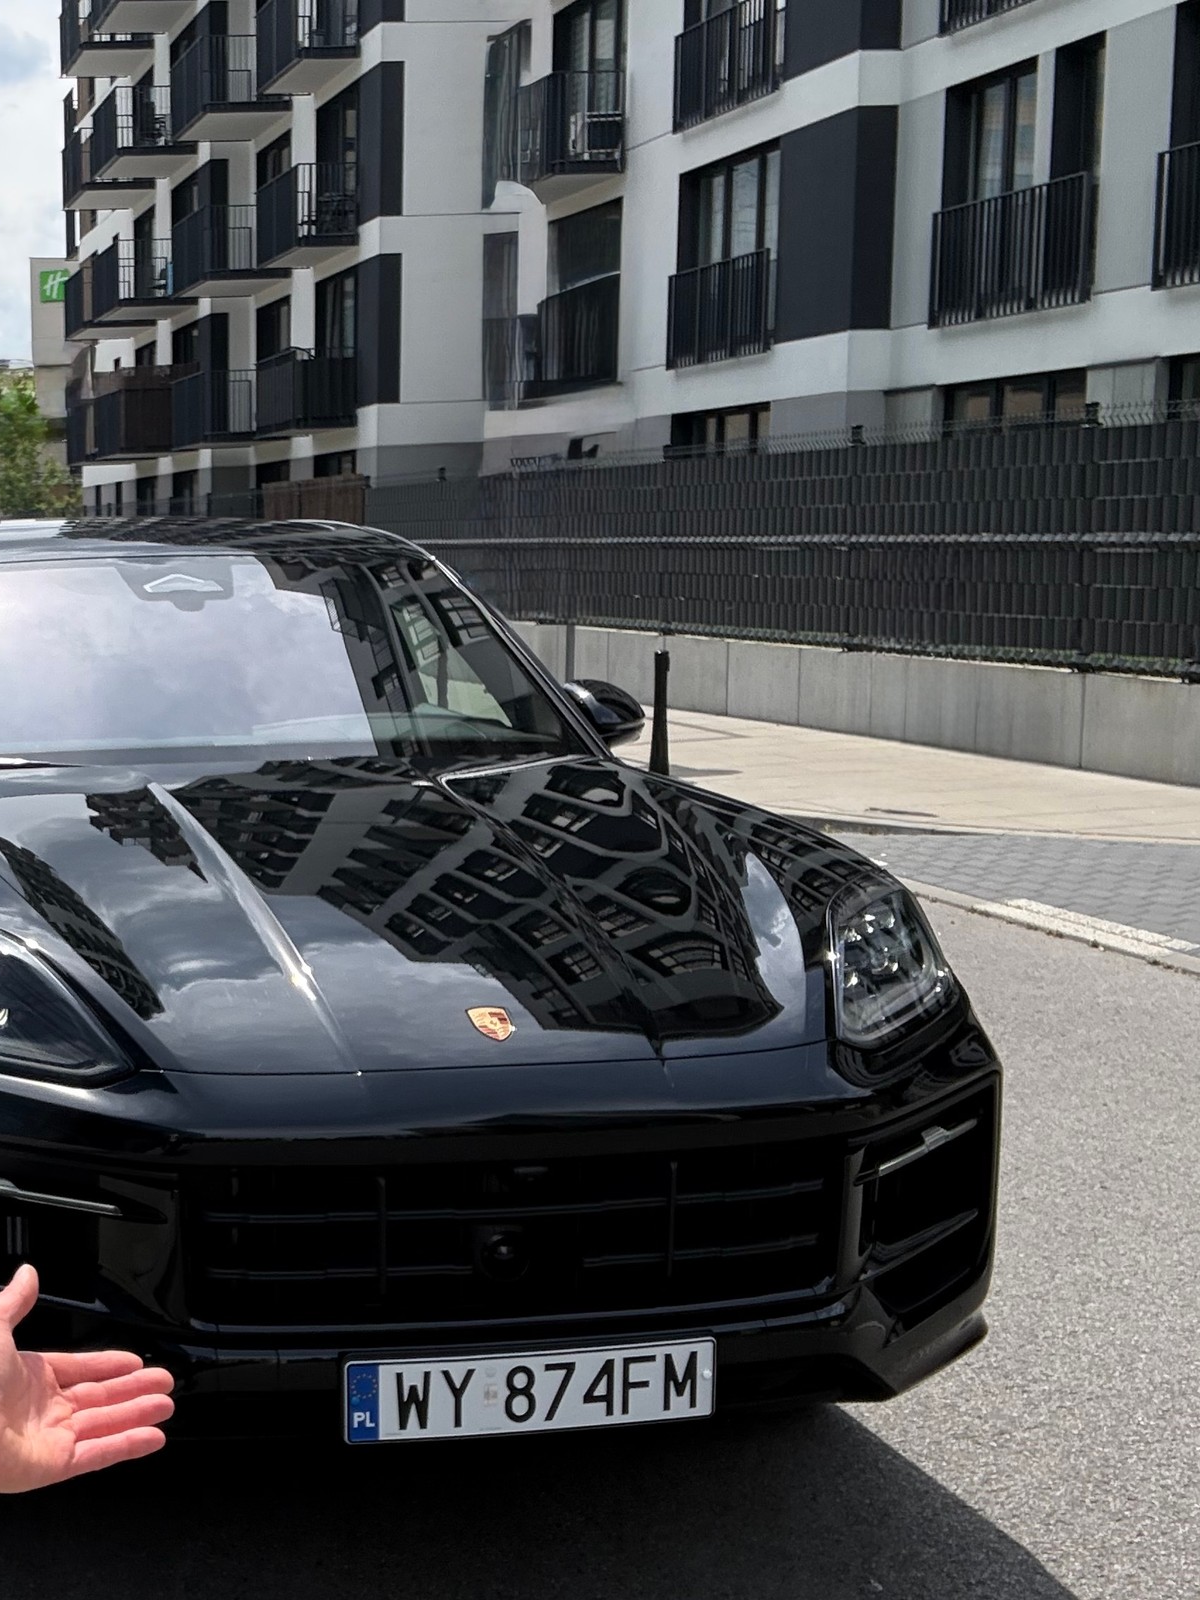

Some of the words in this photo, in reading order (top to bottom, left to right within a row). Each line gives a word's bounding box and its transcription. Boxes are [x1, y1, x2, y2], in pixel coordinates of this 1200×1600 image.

[396, 1368, 476, 1430] WY
[504, 1351, 698, 1423] 874FM
[353, 1412, 375, 1428] PL
